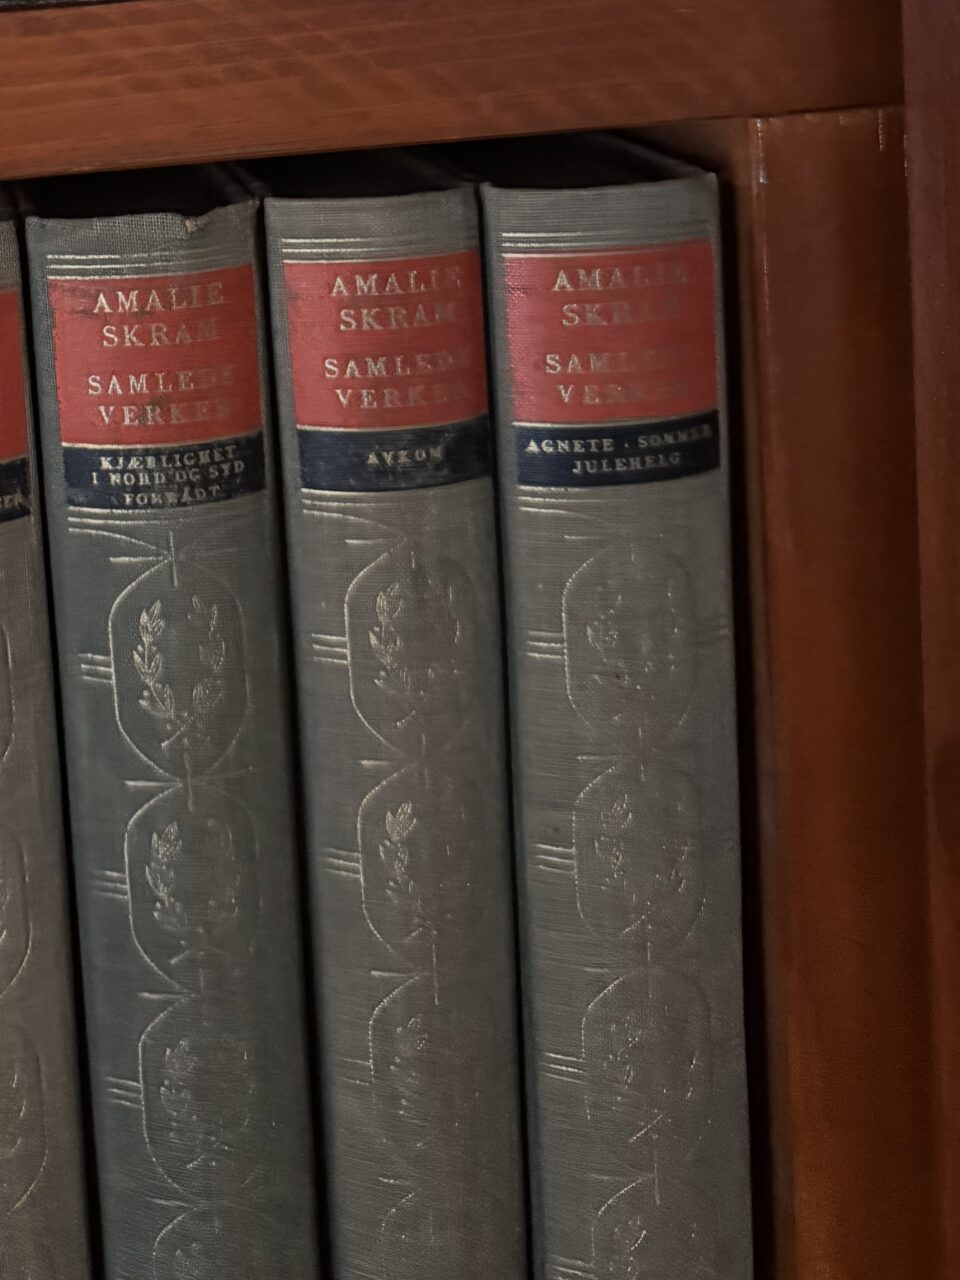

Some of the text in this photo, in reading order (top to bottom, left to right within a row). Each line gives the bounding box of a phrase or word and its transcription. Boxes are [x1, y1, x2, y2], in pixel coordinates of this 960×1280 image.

[93, 281, 226, 314] AMALIE
[562, 298, 680, 327] SKR
[102, 317, 218, 348] SKRAM
[324, 346, 469, 379] SAMLED
[87, 364, 236, 396] SAMLE
[336, 384, 468, 409] VERKE
